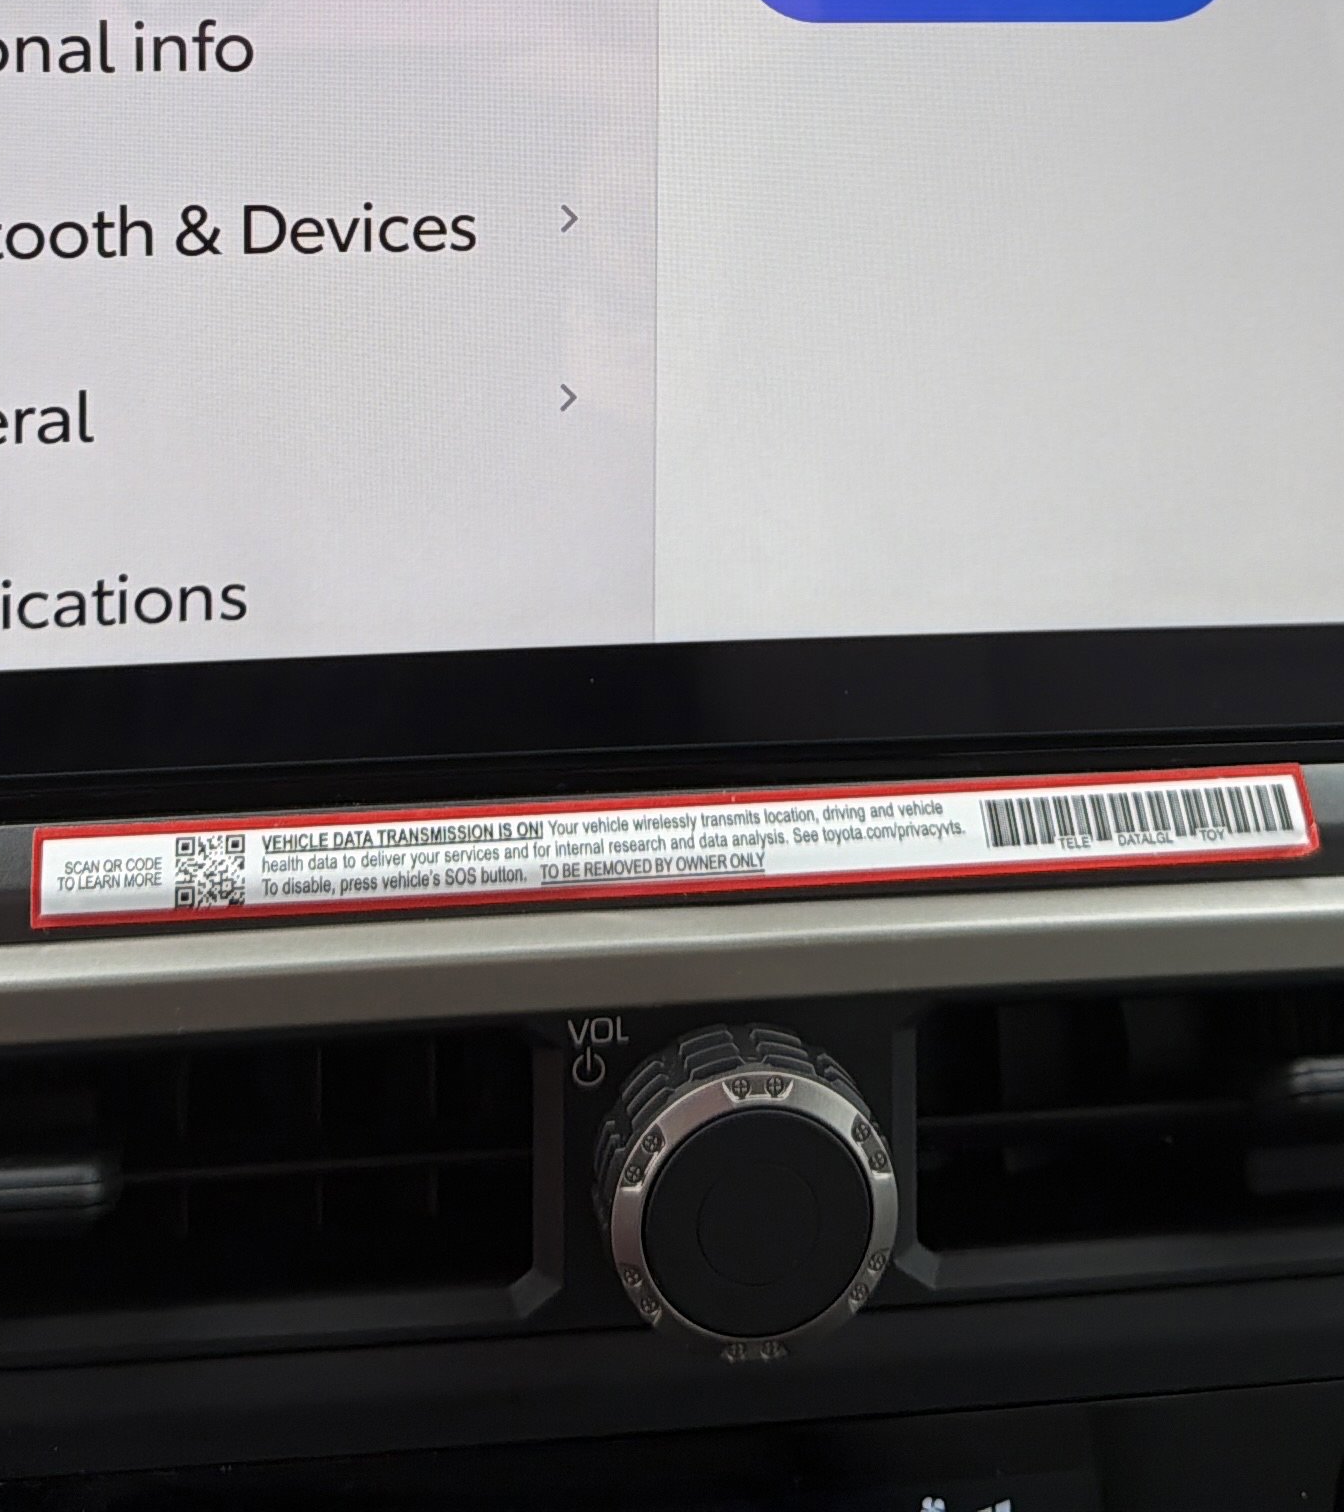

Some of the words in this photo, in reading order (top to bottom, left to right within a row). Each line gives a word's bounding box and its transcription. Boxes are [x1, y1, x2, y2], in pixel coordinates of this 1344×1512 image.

[133, 18, 256, 74] info
[175, 206, 223, 256] &
[242, 200, 478, 256] Devices
[261, 832, 329, 851] VEHICLE
[333, 829, 375, 848] DATA
[377, 823, 494, 846] TRANSMISSION
[498, 823, 512, 838] IS
[516, 821, 544, 839] ON!
[547, 819, 577, 836] Your
[582, 816, 629, 834] vehicle
[632, 812, 697, 832] wirelessly
[700, 806, 761, 828] transmits
[763, 804, 819, 826] location,
[822, 803, 866, 824] driving
[870, 801, 895, 818] and
[897, 799, 943, 817] vehicle
[1058, 834, 1092, 851] TELE
[1199, 826, 1226, 842] TOY
[64, 859, 100, 875] SCAN
[103, 858, 123, 874] QR
[125, 856, 163, 871] CODE
[261, 853, 304, 874] health
[308, 852, 338, 870] data
[342, 851, 357, 869] to
[361, 849, 406, 868] deliver
[410, 848, 439, 870] your
[444, 845, 500, 863] services
[504, 842, 530, 860] and
[532, 841, 551, 858] for
[555, 838, 605, 857] internal
[608, 835, 667, 854] research
[670, 833, 696, 851] and
[699, 831, 729, 849] data
[732, 827, 789, 848] analysis.
[792, 826, 819, 844] See
[261, 878, 279, 896] To
[282, 875, 336, 897] disable,
[340, 876, 378, 895] press
[382, 868, 441, 890] vehicle's
[444, 866, 477, 885] SOS
[480, 864, 528, 884] button.
[540, 863, 560, 880] TO
[562, 861, 581, 878] BE
[584, 857, 653, 877] REMOVED
[655, 856, 674, 874] BY
[676, 852, 728, 872] OWNER
[730, 850, 766, 869] ONLY
[57, 875, 75, 891] TO
[78, 873, 121, 890] LEARN
[123, 871, 162, 888] MORE
[567, 1016, 629, 1046] VOL
